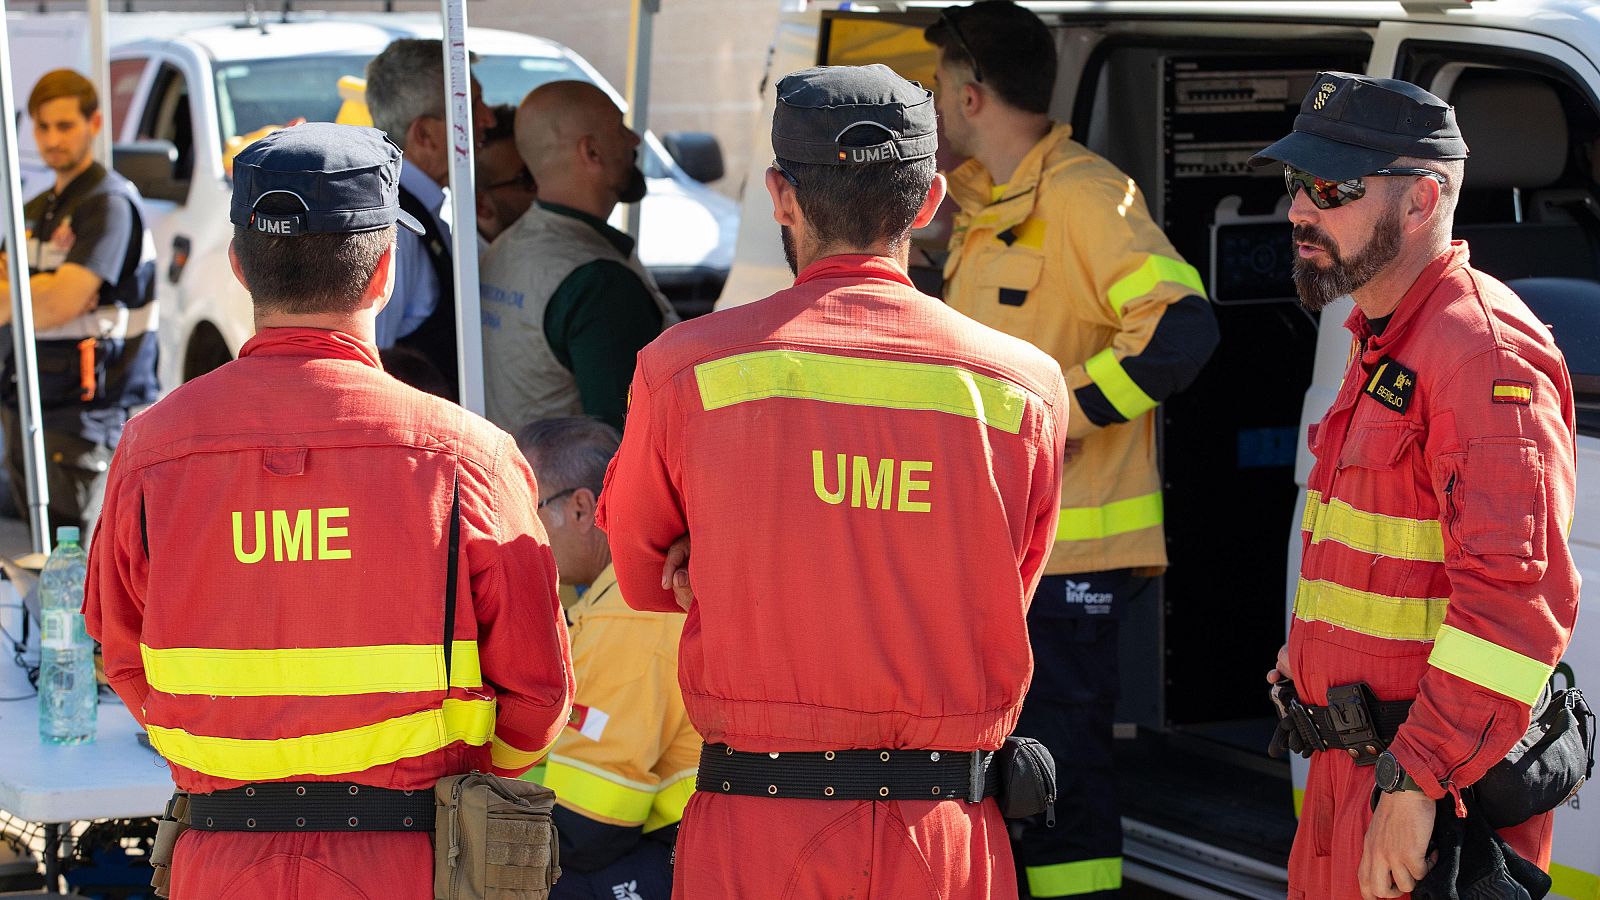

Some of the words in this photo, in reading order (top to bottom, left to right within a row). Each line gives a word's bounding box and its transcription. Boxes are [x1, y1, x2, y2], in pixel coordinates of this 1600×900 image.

[852, 145, 890, 163] UME
[257, 217, 291, 234] UME
[812, 450, 933, 513] UME
[232, 507, 352, 564] UME
